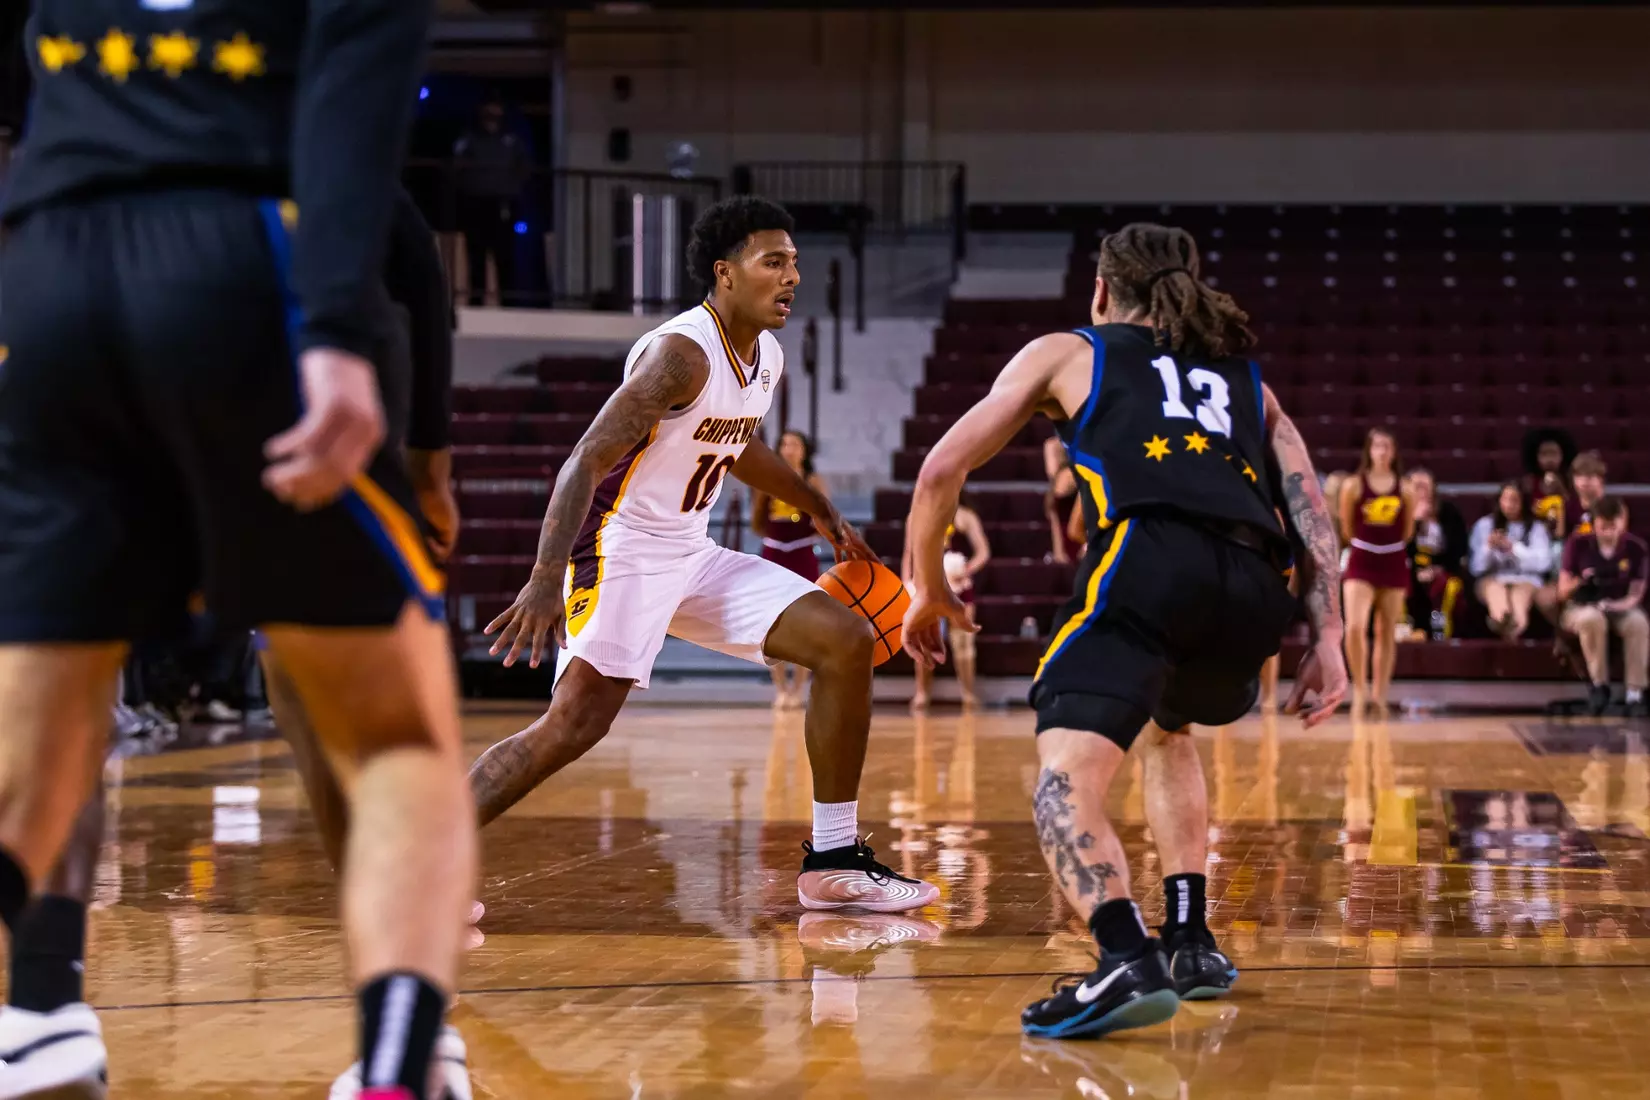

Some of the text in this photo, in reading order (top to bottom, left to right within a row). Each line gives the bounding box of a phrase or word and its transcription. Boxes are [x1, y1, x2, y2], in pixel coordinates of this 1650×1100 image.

[1151, 355, 1232, 440] 13
[692, 416, 763, 445] CHIPPEWA
[680, 453, 737, 513] 10
